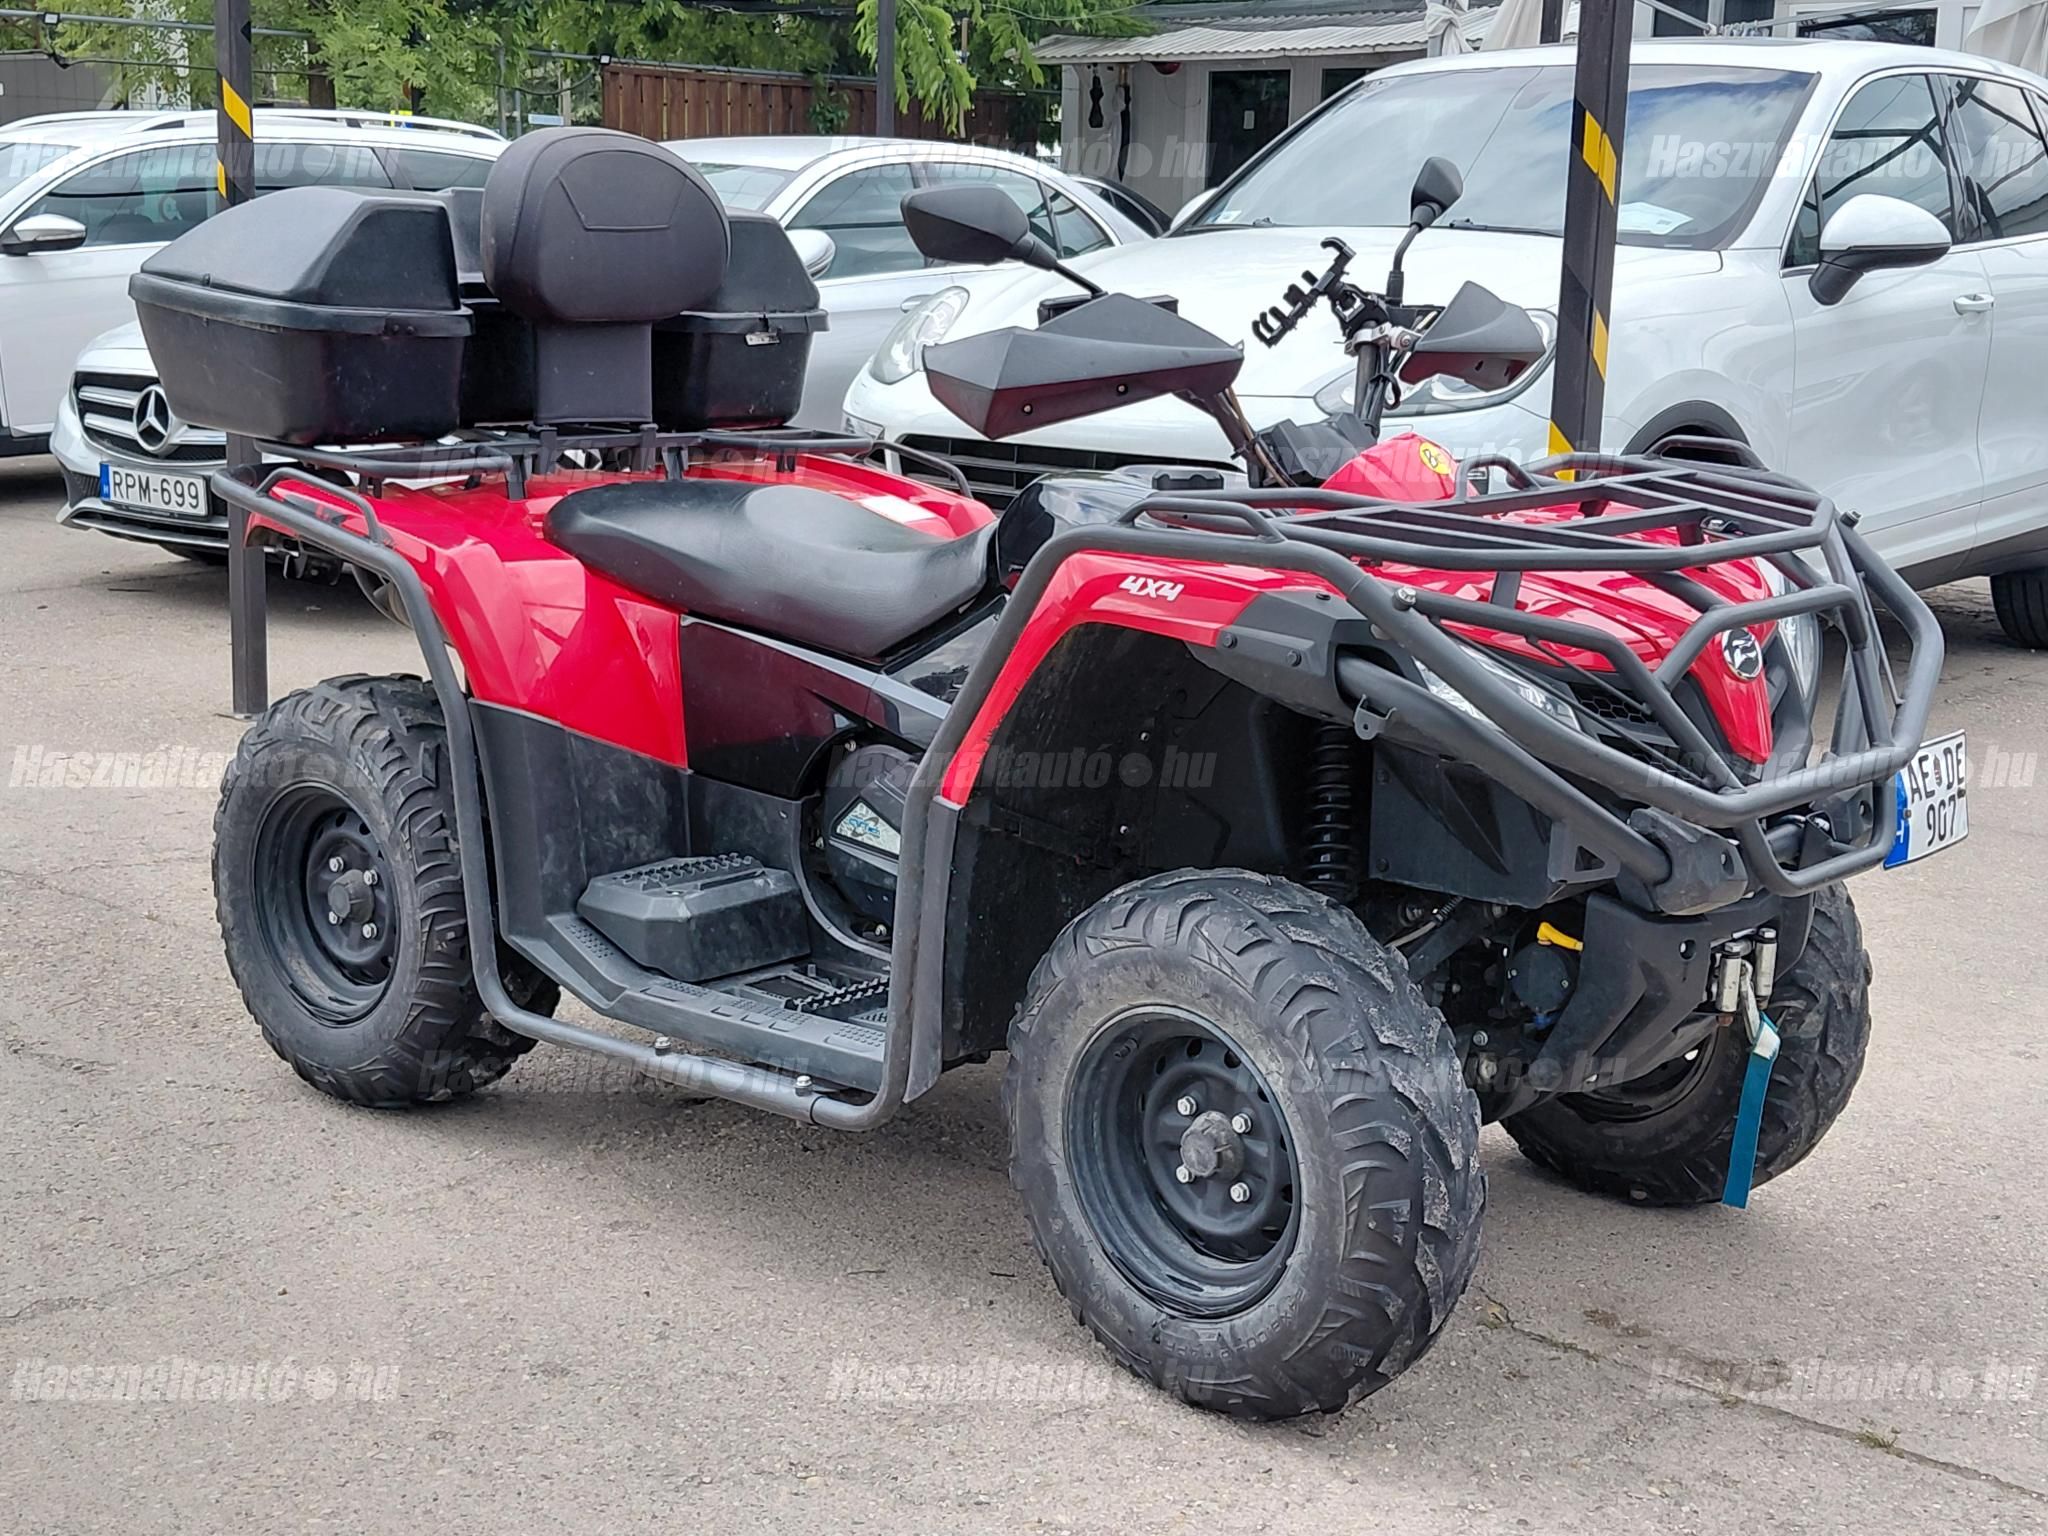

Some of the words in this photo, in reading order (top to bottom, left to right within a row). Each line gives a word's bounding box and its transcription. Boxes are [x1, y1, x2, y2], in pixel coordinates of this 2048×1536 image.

[112, 471, 199, 509] RPM-699
[1907, 754, 1936, 804] AE
[1943, 741, 1965, 790] DE
[1926, 793, 1957, 847] 907
